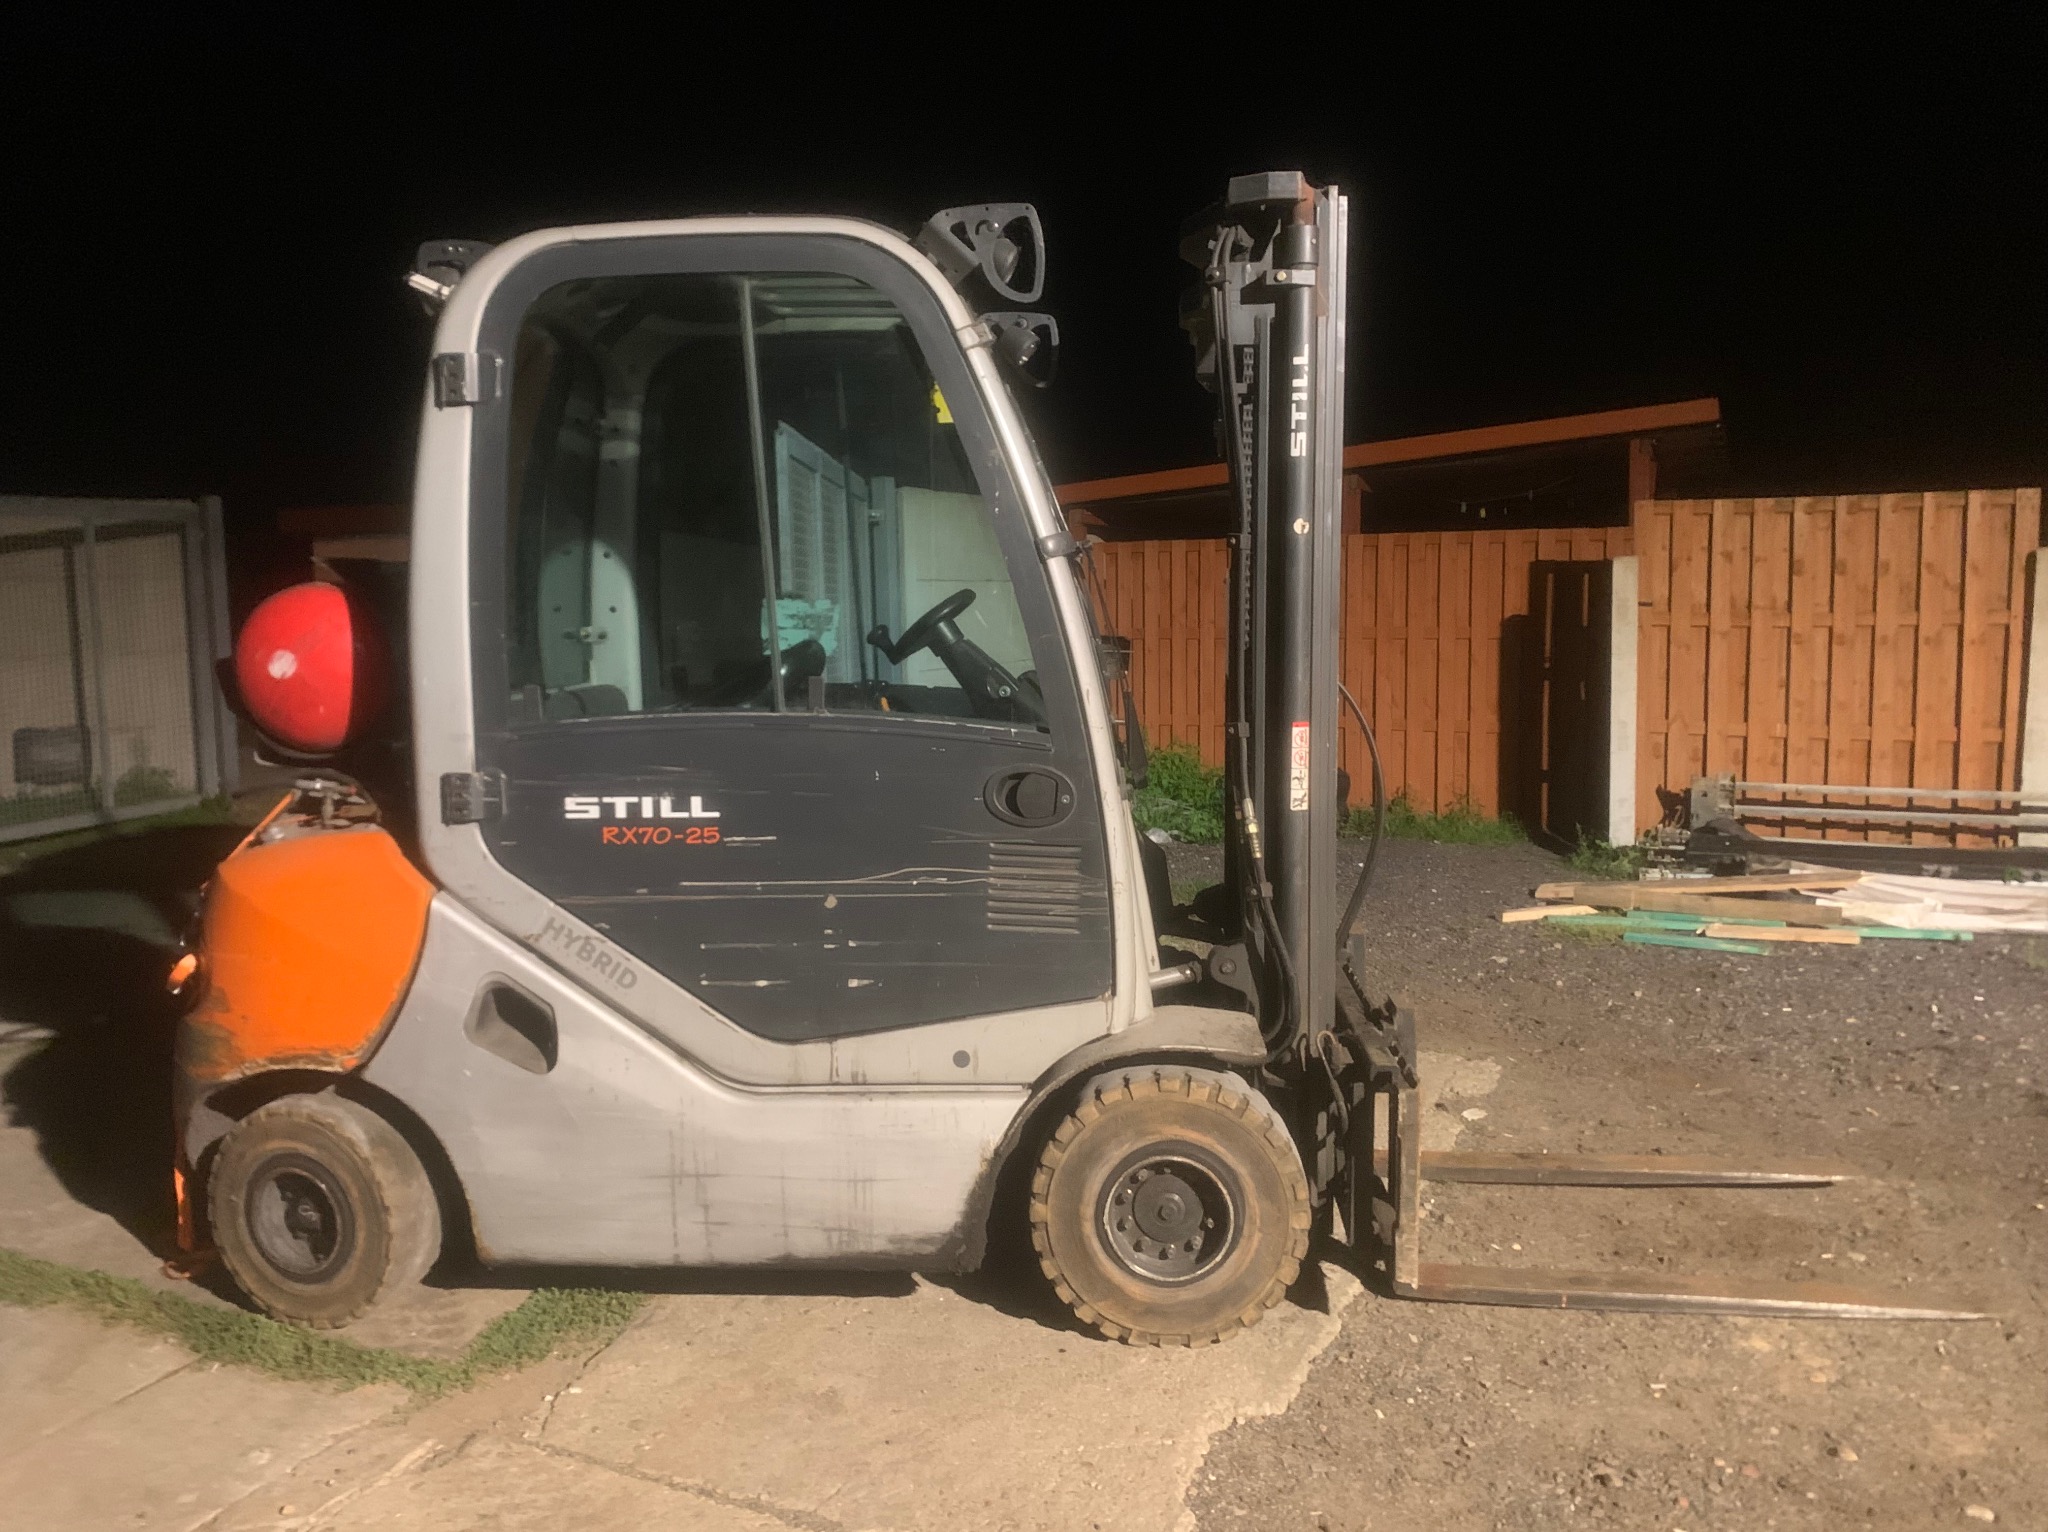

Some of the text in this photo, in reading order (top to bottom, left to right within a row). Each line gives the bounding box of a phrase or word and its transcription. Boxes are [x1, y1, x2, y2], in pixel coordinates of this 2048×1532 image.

[1290, 343, 1309, 457] STILL
[564, 796, 720, 819] STILL
[602, 827, 720, 845] RX70-25
[541, 917, 638, 989] HYBRID
